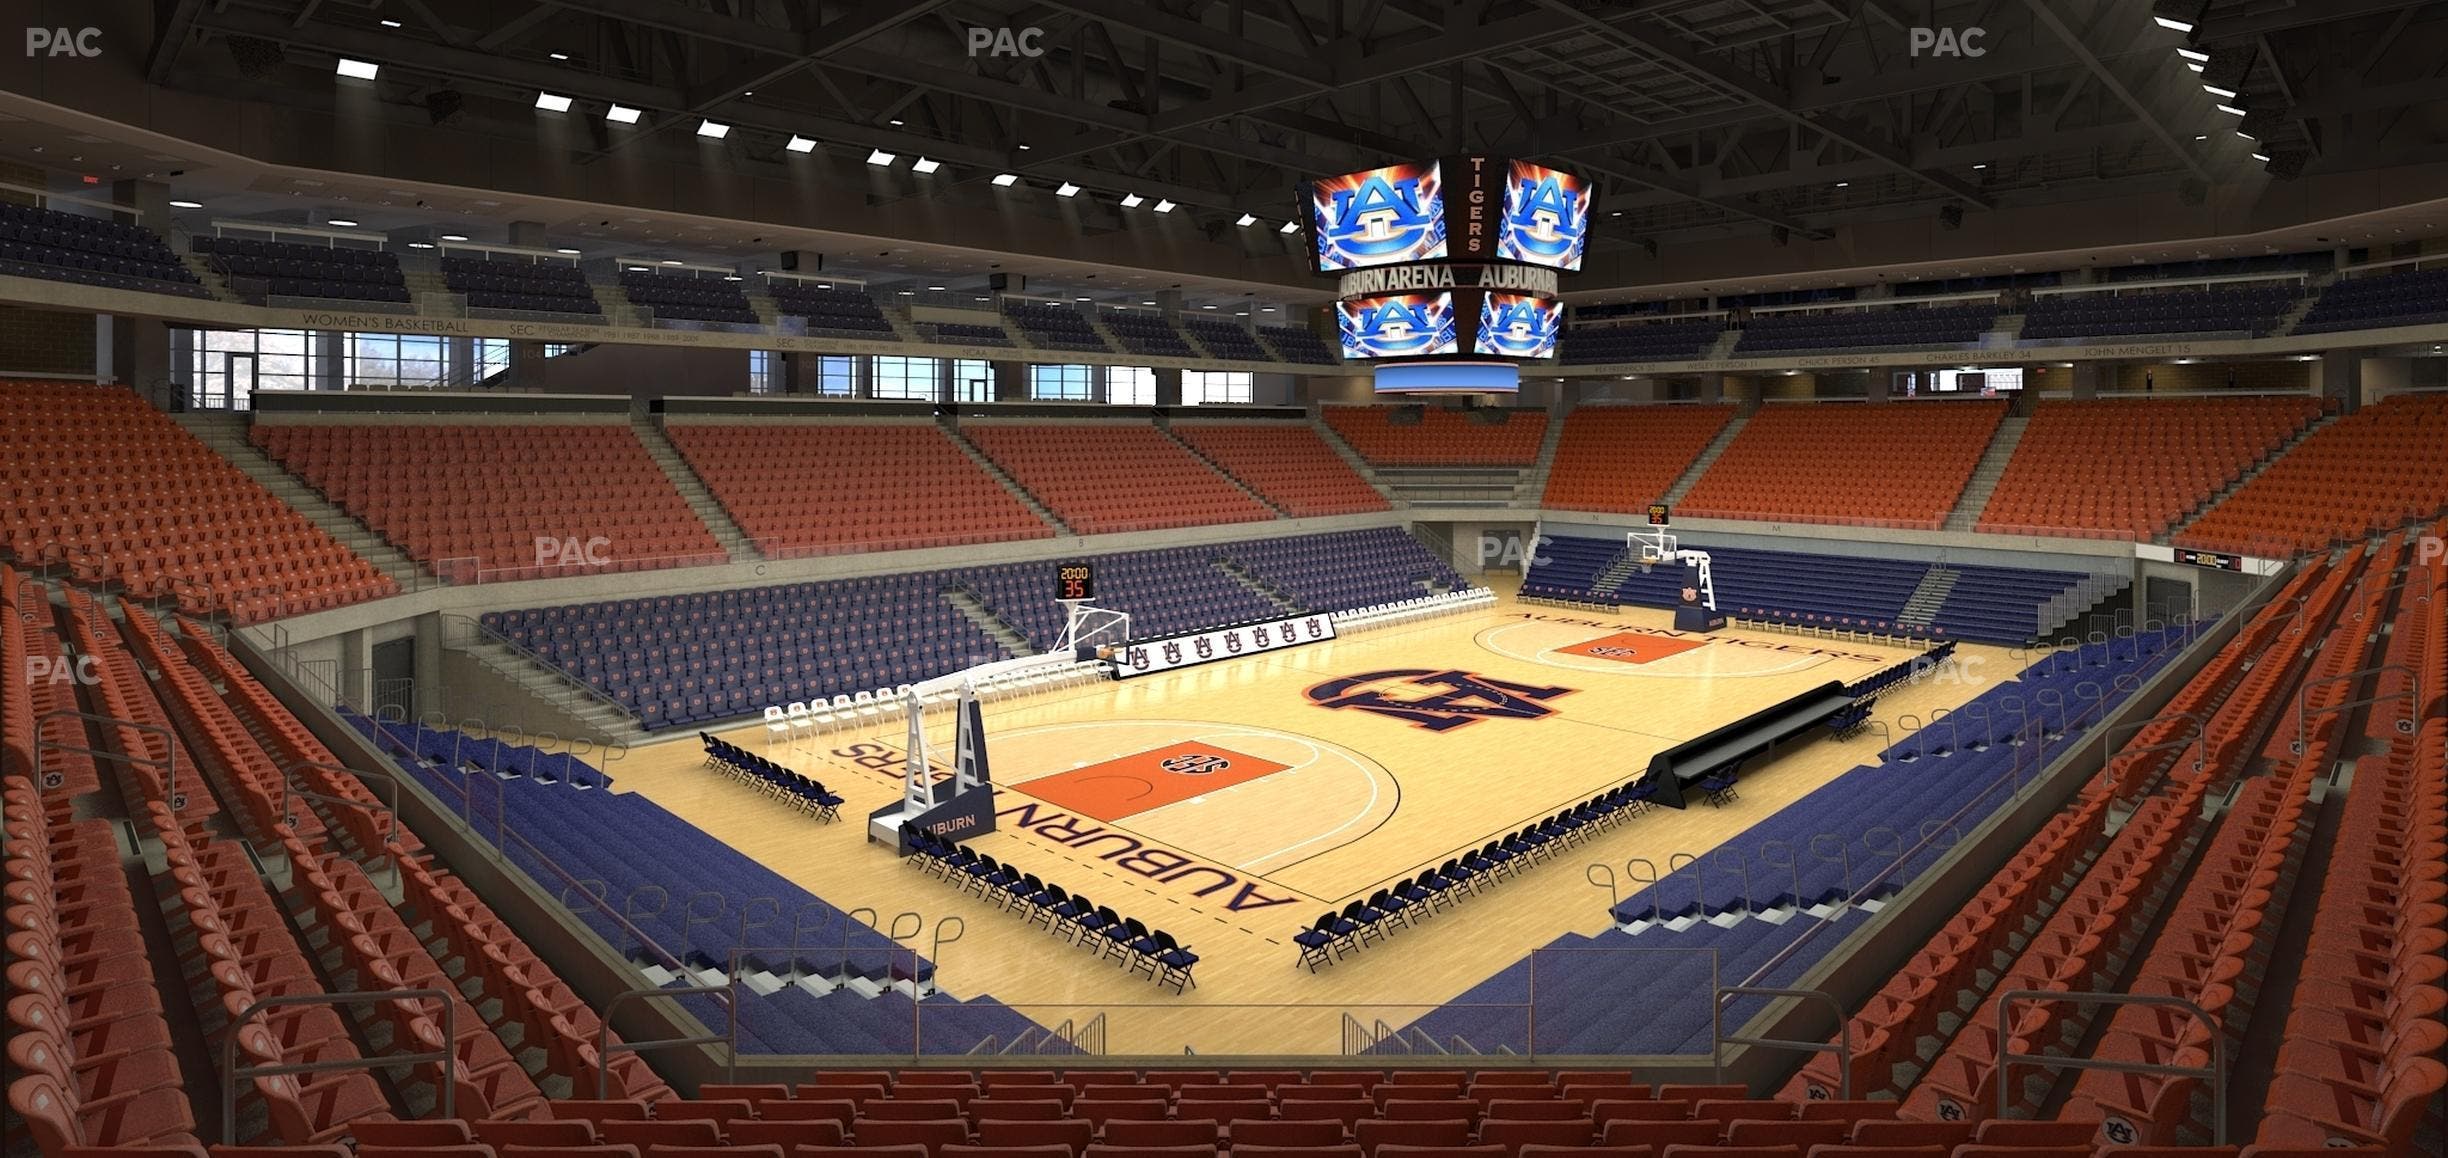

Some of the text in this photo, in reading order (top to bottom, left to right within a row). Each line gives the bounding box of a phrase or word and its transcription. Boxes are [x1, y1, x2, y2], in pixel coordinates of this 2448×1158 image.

[1468, 157, 1485, 251] TIGERS
[1387, 264, 1456, 292] ARENA
[1479, 264, 1544, 293] AUBURN
[302, 313, 469, 332] WOMEN'S BASKETBALL
[509, 324, 536, 337] SEC
[1926, 350, 2032, 362] CHARLES BARKLEY 34
[2084, 344, 2191, 358] JOHN MENGELT 15
[1830, 356, 1867, 366] PERSON
[1061, 567, 1088, 580] 20:00
[1065, 580, 1084, 597] 35
[1505, 612, 1886, 664] AUBURN TIGERS
[919, 814, 976, 837] UBURN
[997, 802, 1304, 913] AUBURN
